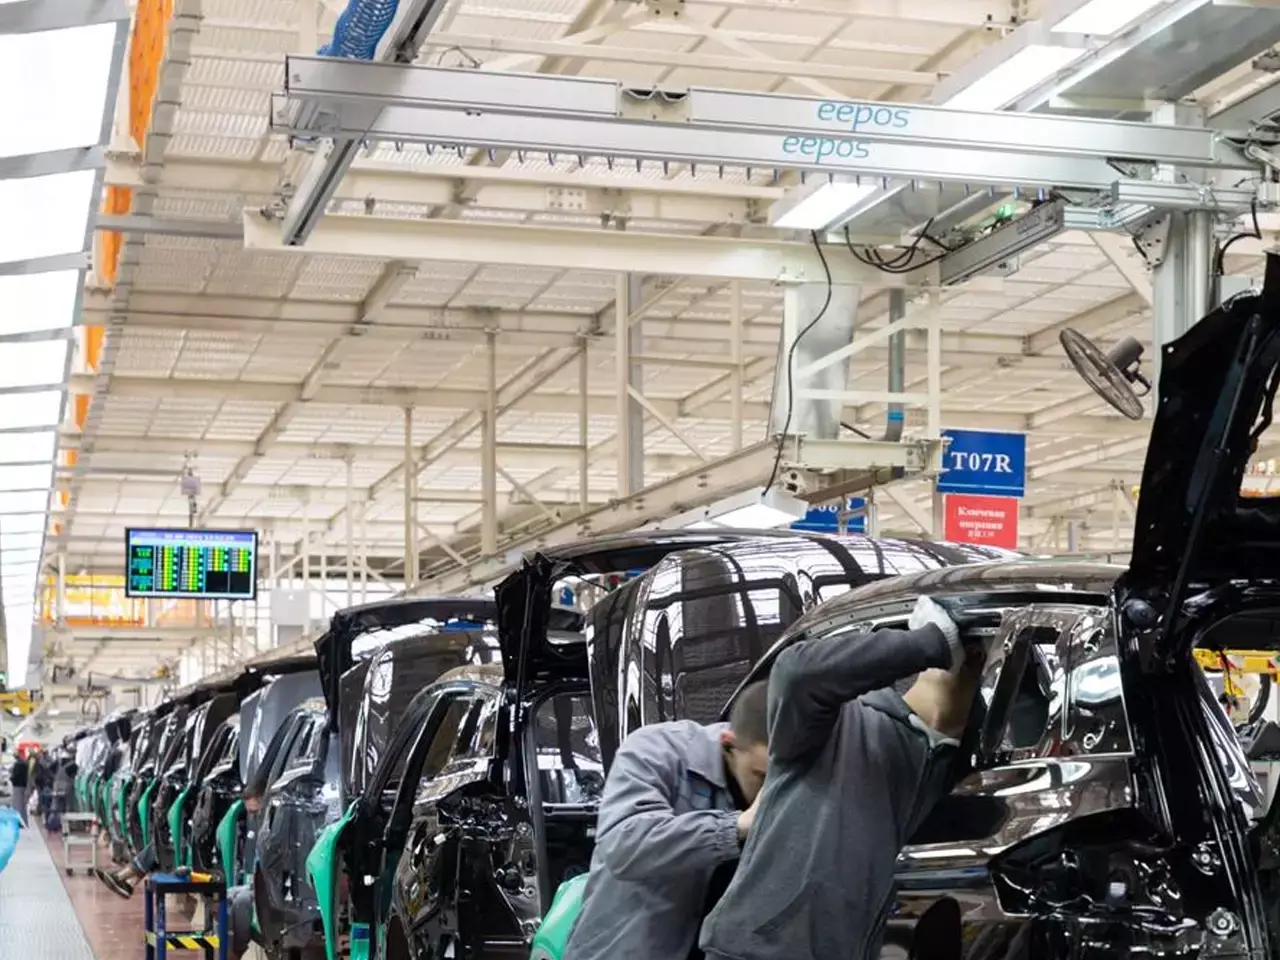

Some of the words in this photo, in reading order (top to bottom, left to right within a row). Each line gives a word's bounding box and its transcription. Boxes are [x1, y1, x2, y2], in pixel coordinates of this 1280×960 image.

[817, 102, 911, 131] eepos
[782, 135, 871, 164] eepos
[951, 452, 1013, 473] T07R
